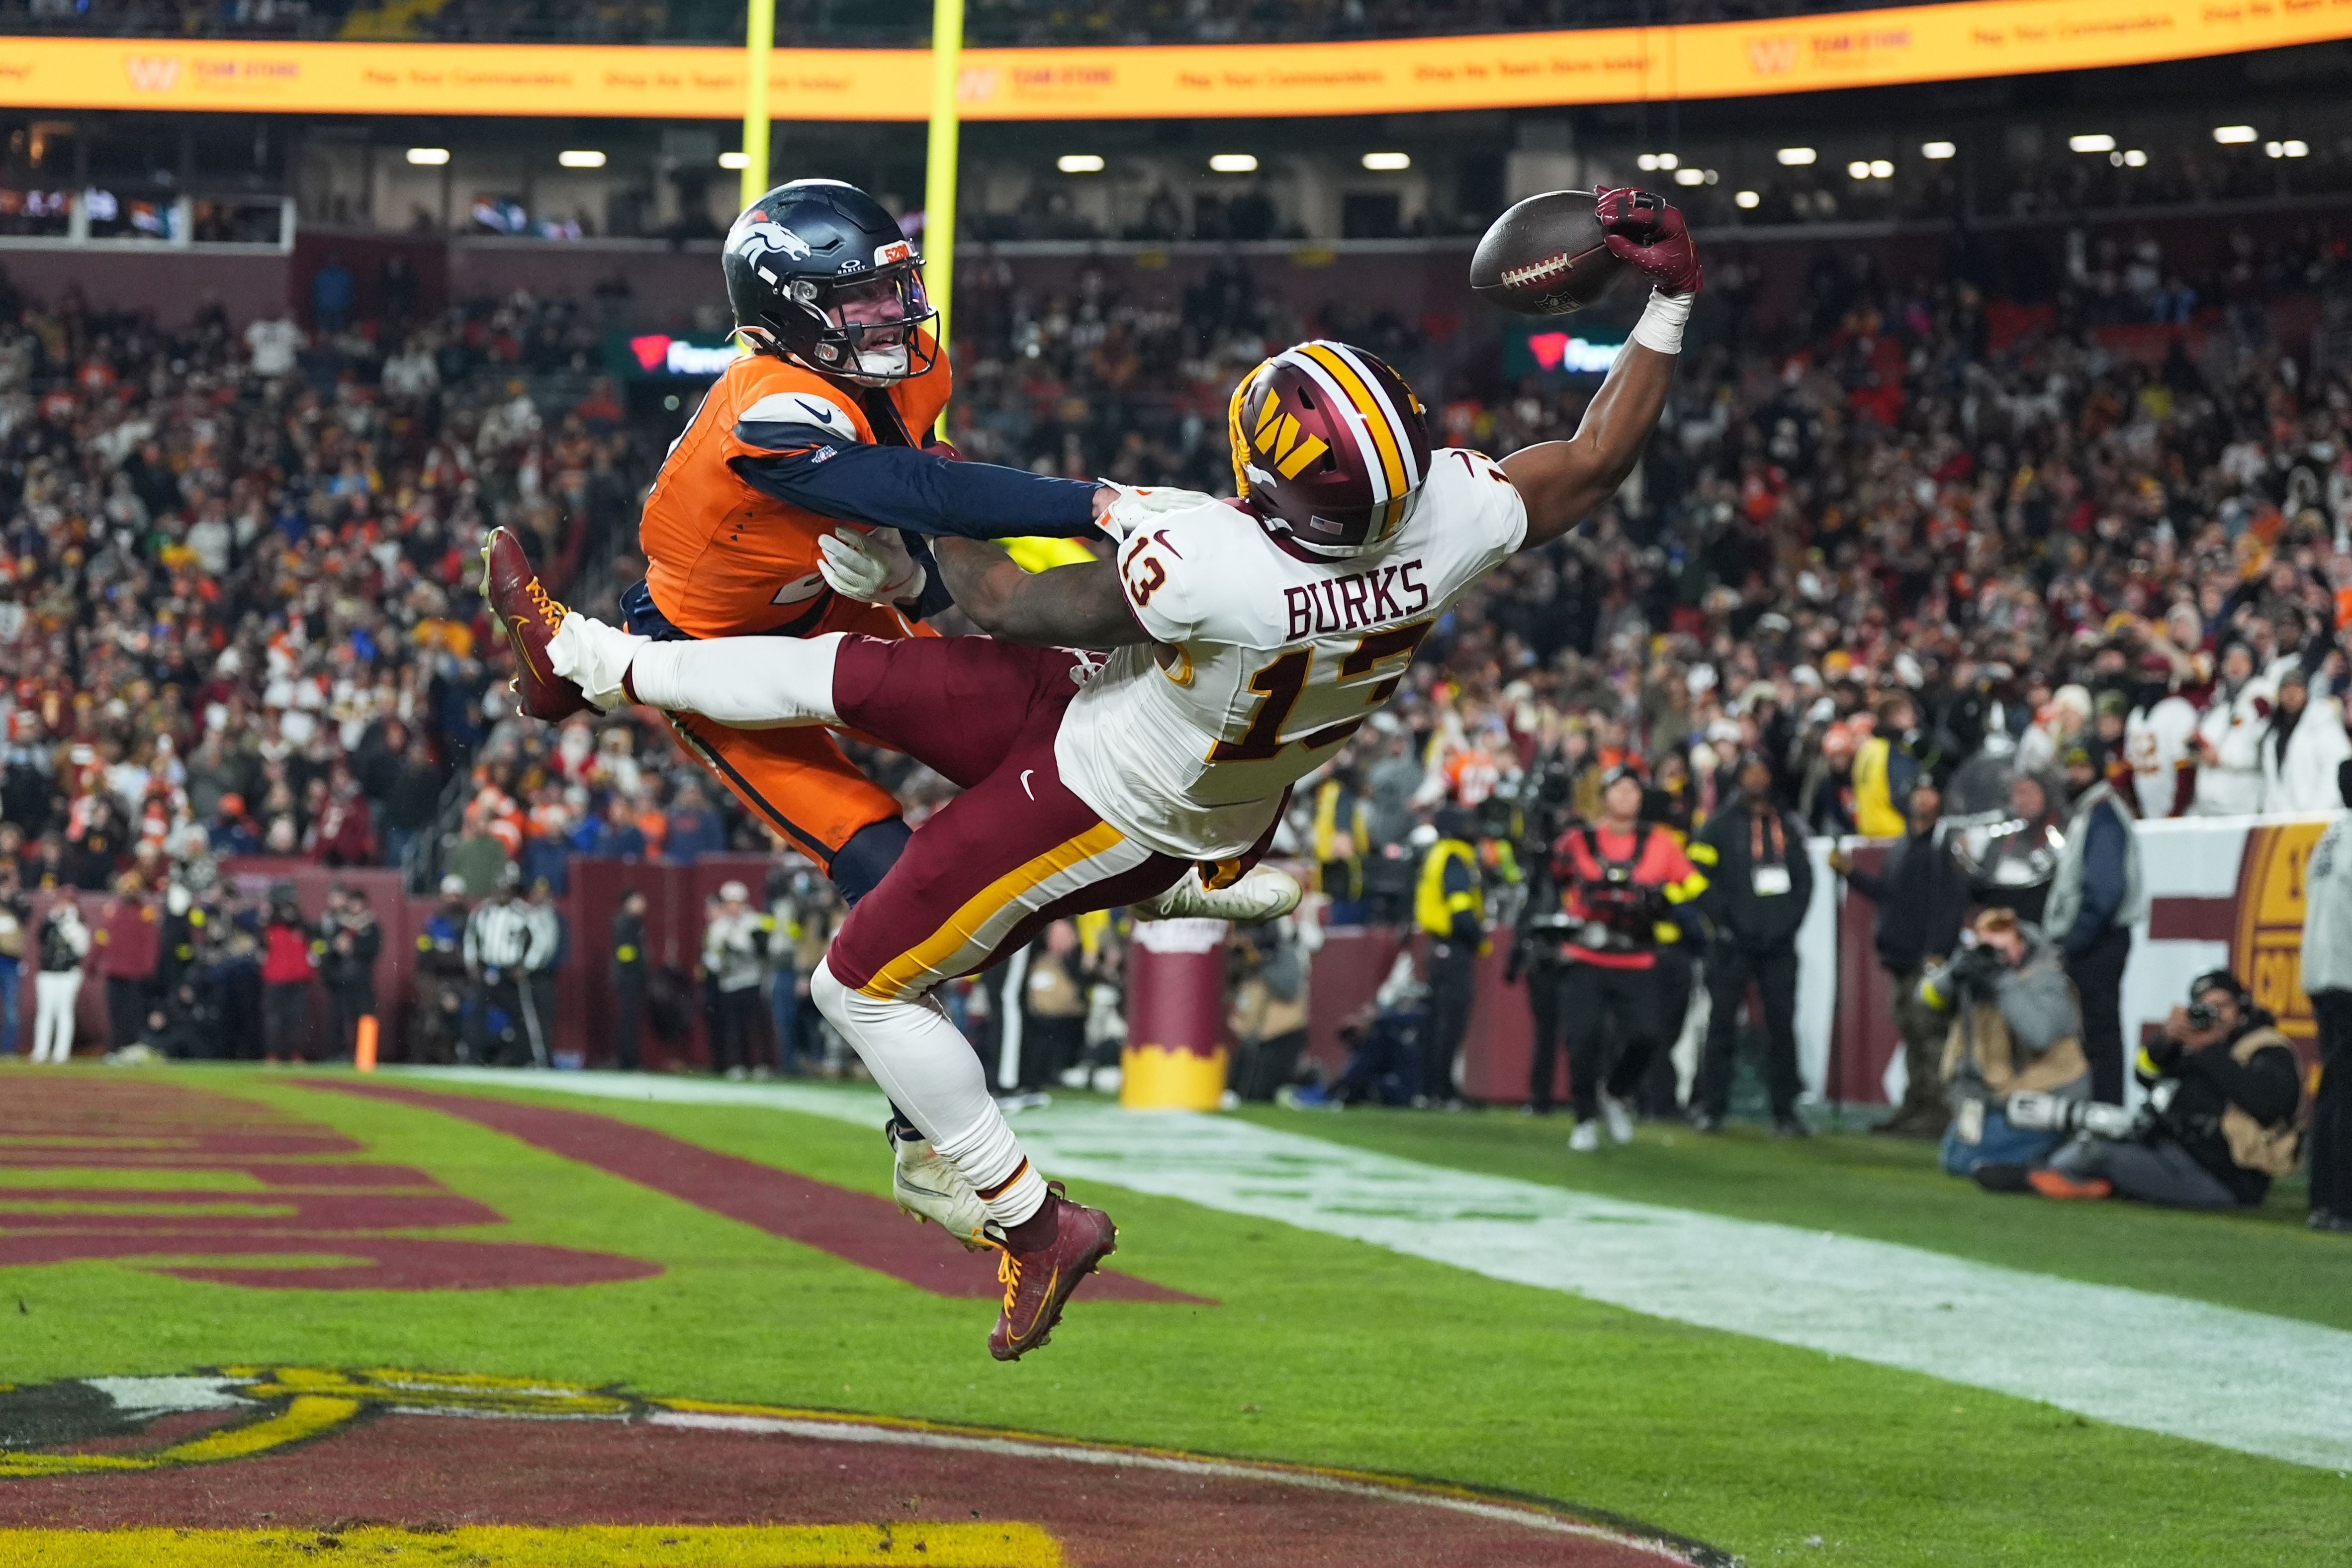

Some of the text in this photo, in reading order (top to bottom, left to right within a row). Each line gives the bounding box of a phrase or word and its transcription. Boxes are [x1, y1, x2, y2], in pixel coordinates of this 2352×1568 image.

[1121, 536, 1166, 608] 13
[1283, 559, 1429, 642] BURKS
[1205, 618, 1436, 763] 13
